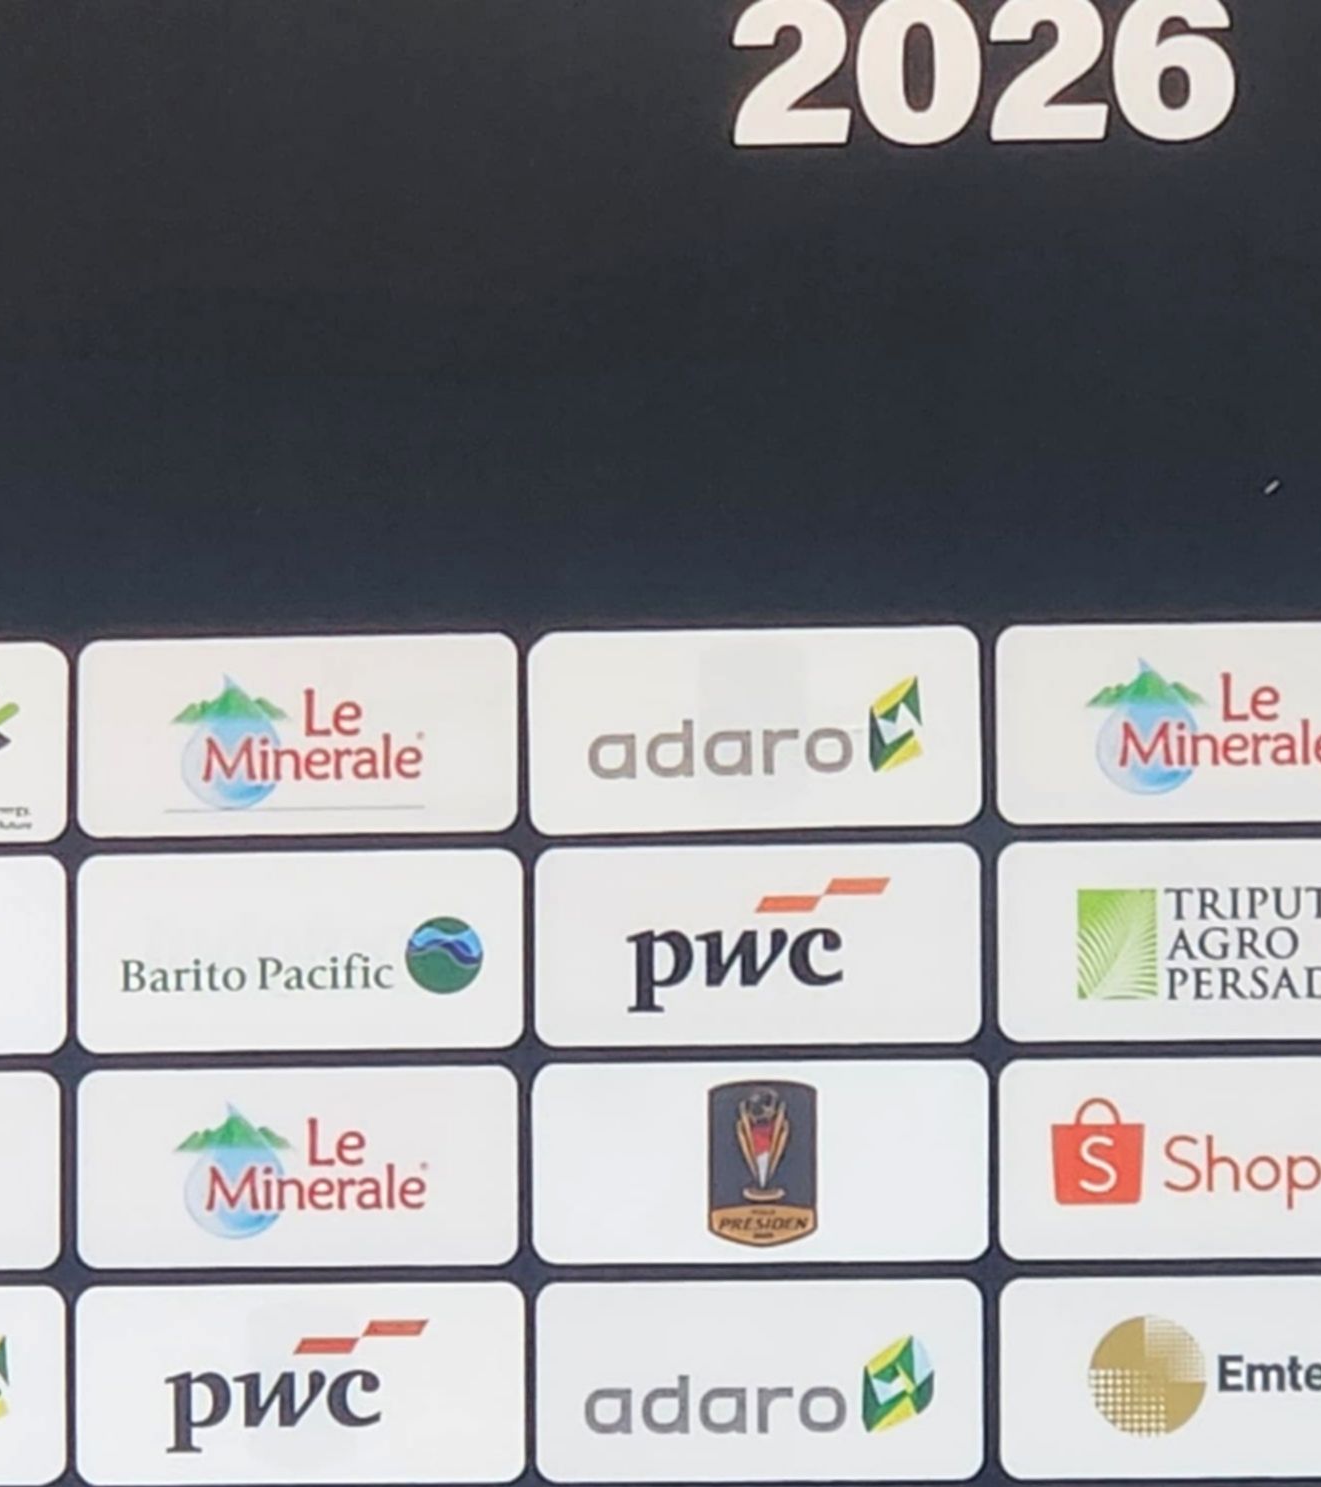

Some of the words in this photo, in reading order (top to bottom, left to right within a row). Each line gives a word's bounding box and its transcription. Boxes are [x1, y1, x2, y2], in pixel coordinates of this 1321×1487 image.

[732, 0, 1235, 146] 2026
[304, 688, 362, 737] Le
[1222, 672, 1281, 722] Le
[204, 735, 422, 780] Minerale
[588, 719, 853, 779] adaro
[1166, 926, 1299, 961] AGRO
[122, 959, 246, 992] Barito
[258, 953, 393, 990] Pacific
[626, 928, 843, 1013] pwc
[307, 1118, 364, 1167] Le
[207, 1166, 424, 1211] Minerale
[164, 1369, 381, 1453] pwc
[585, 1375, 846, 1434] adaro
